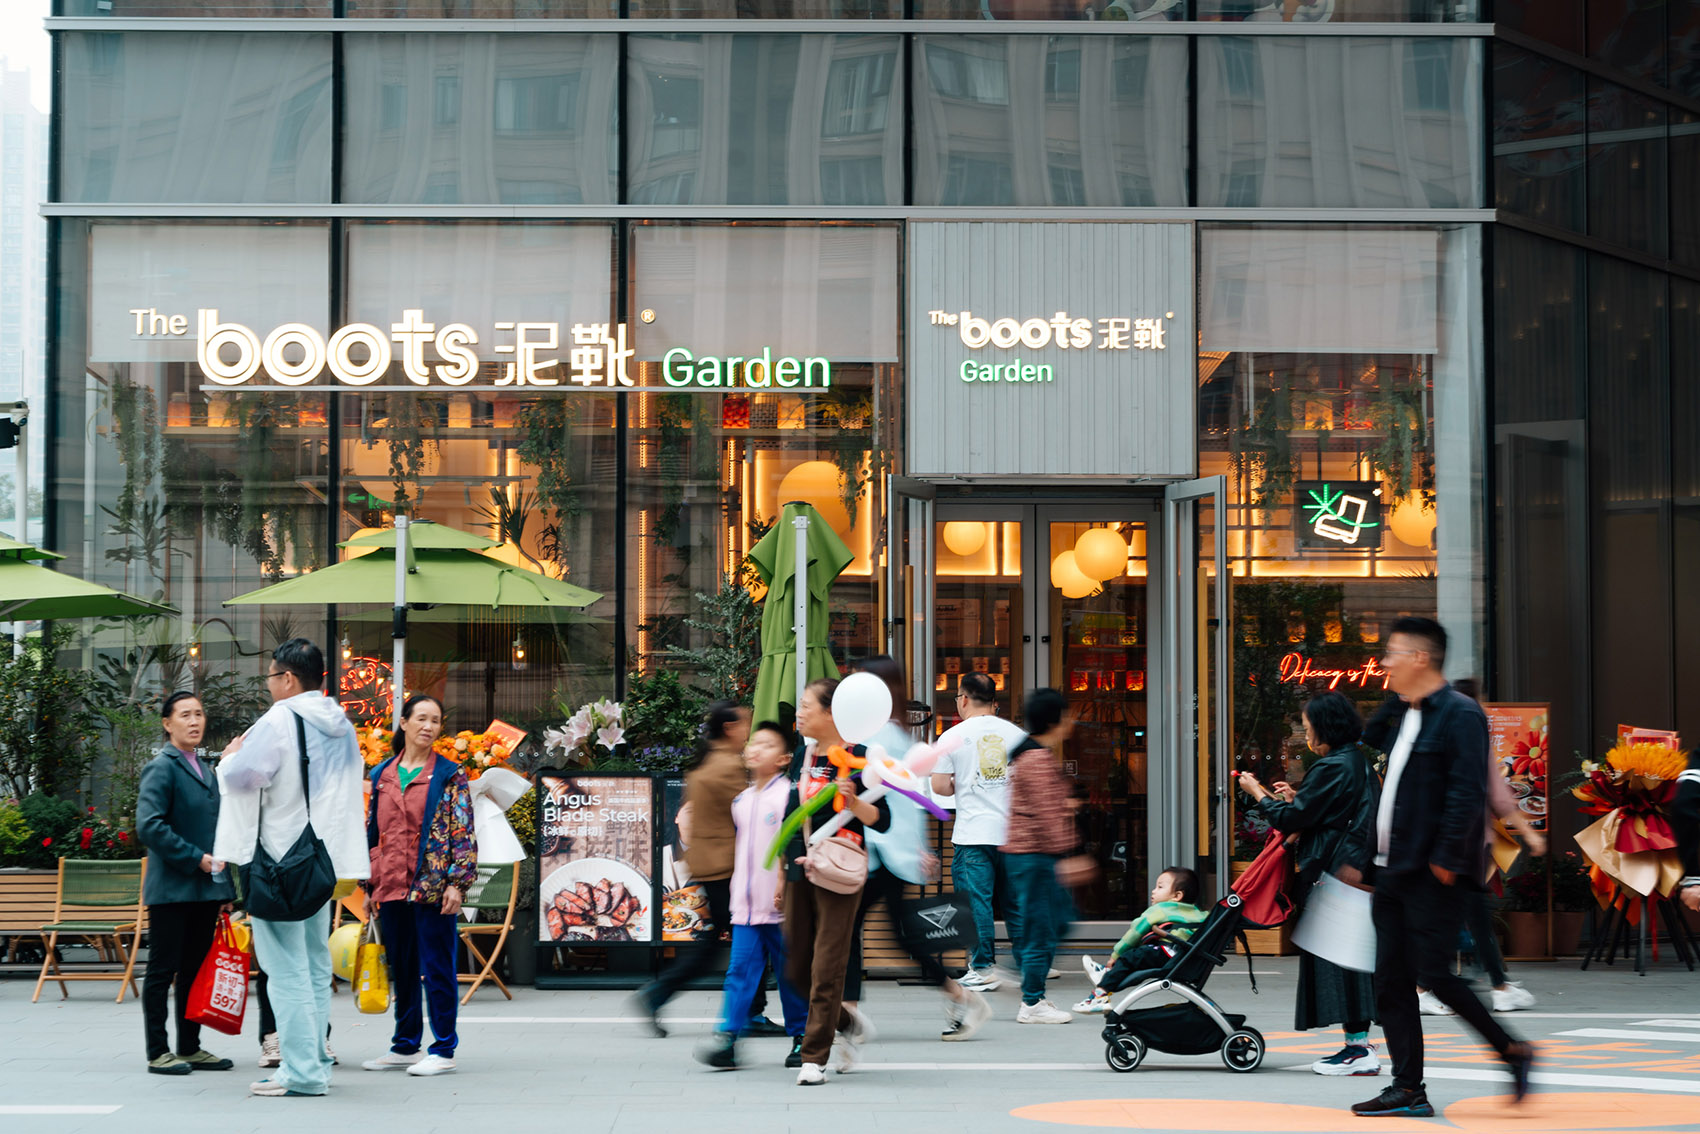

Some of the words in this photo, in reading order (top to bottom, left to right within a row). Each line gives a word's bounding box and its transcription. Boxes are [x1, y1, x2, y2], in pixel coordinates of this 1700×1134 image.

[928, 310, 959, 326] The
[959, 311, 1093, 349] boots
[1098, 318, 1166, 350] 泥靴
[129, 308, 189, 336] The
[197, 308, 480, 386] boots
[494, 321, 635, 387] 泥靴
[661, 346, 831, 388] Garden
[960, 358, 1054, 383] Garden
[543, 792, 601, 809] Angus
[544, 808, 595, 822] Blade
[599, 808, 649, 822] Steak
[213, 993, 238, 1010] 597
